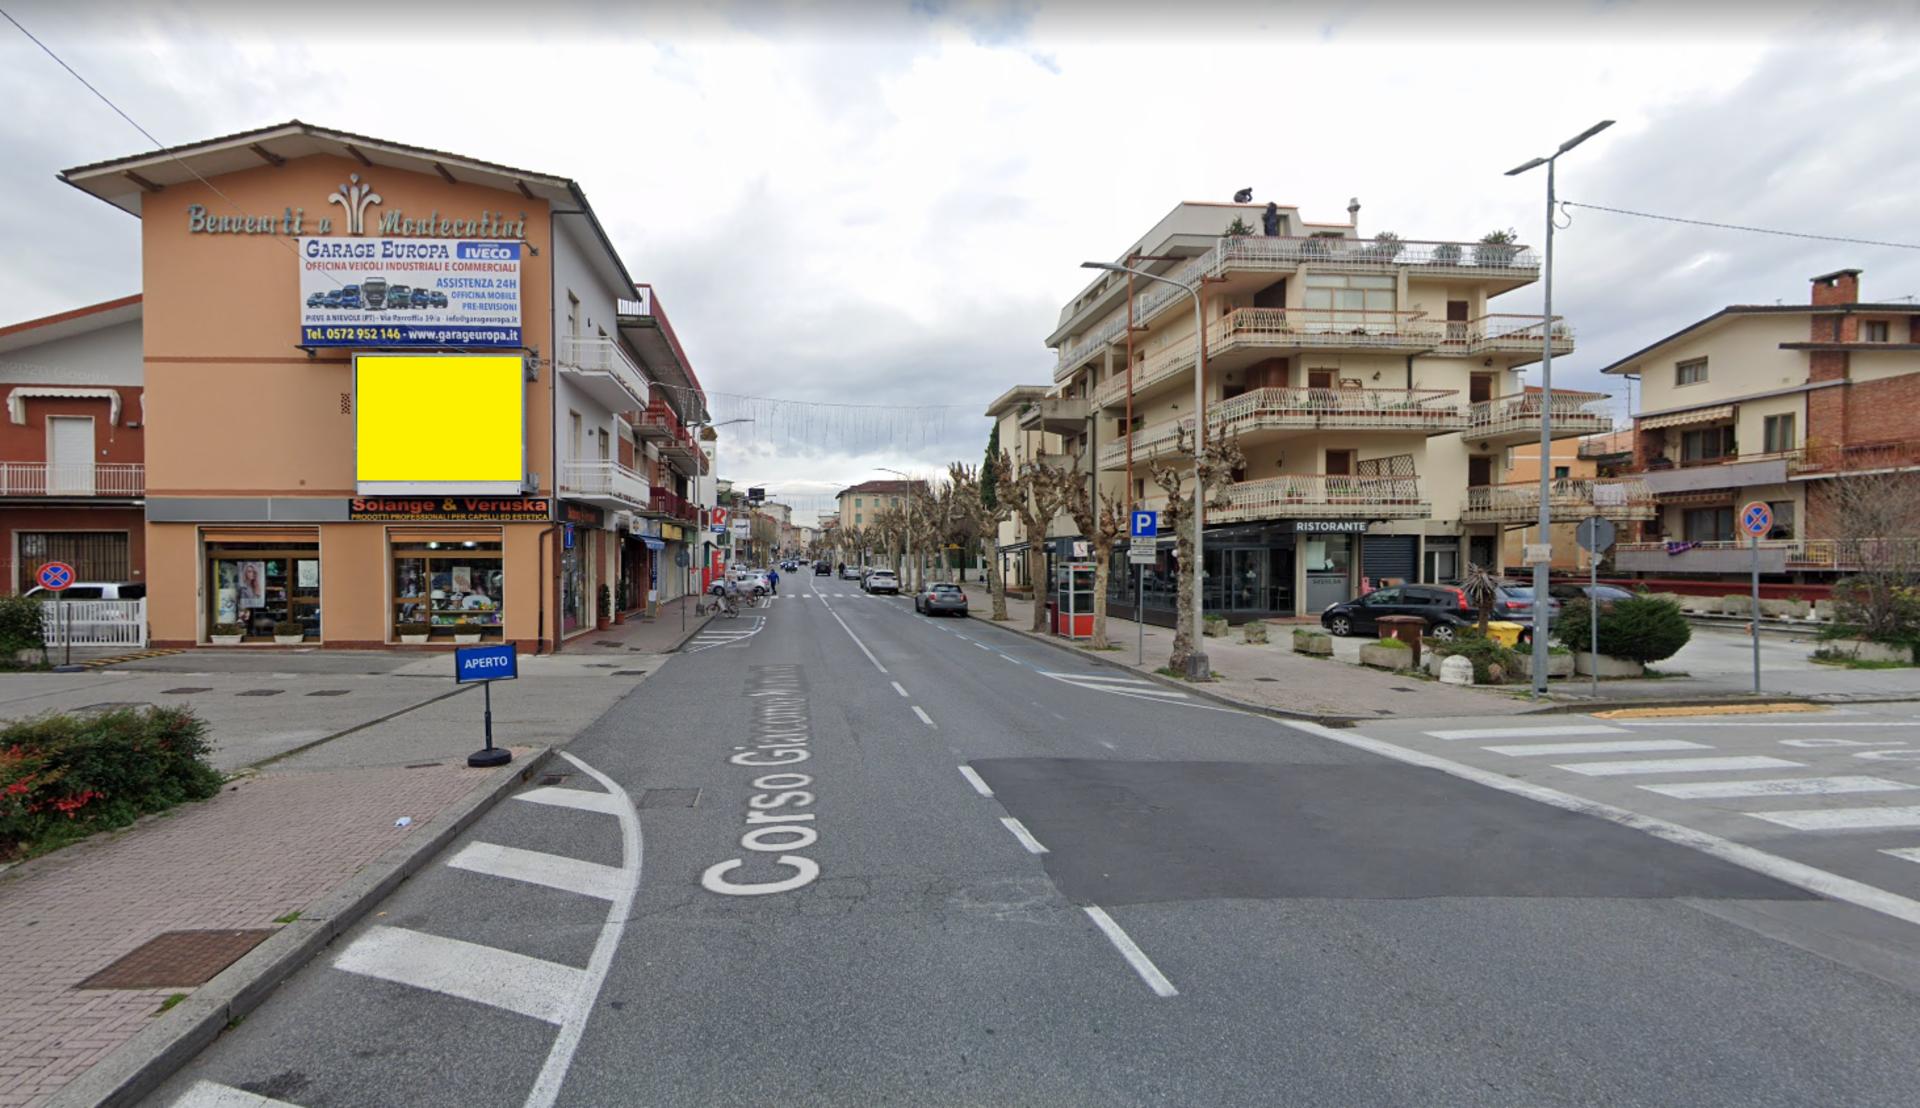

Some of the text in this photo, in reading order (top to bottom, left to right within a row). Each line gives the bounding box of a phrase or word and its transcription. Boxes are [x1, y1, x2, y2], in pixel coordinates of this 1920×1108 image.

[378, 208, 527, 238] Montecatini
[306, 240, 449, 259] GARAGE EUROPA
[464, 247, 512, 259] IVECO
[305, 261, 517, 273] OFFICINA VEICOLI INDUSTRIALI E COMMERCIALI
[436, 277, 517, 289] ASSISTENZA 24H
[451, 291, 517, 300] OFFICINA MOBILE
[462, 302, 518, 311] PRE-REVISIONI
[306, 328, 325, 339] Tel.
[326, 328, 354, 340] 0572
[357, 328, 378, 340] 952
[380, 328, 400, 340] 146
[408, 329, 518, 343] www.garageuropa.it
[352, 497, 547, 514] Solange & Veruska
[1137, 514, 1151, 533] P
[464, 655, 508, 669] APERTO
